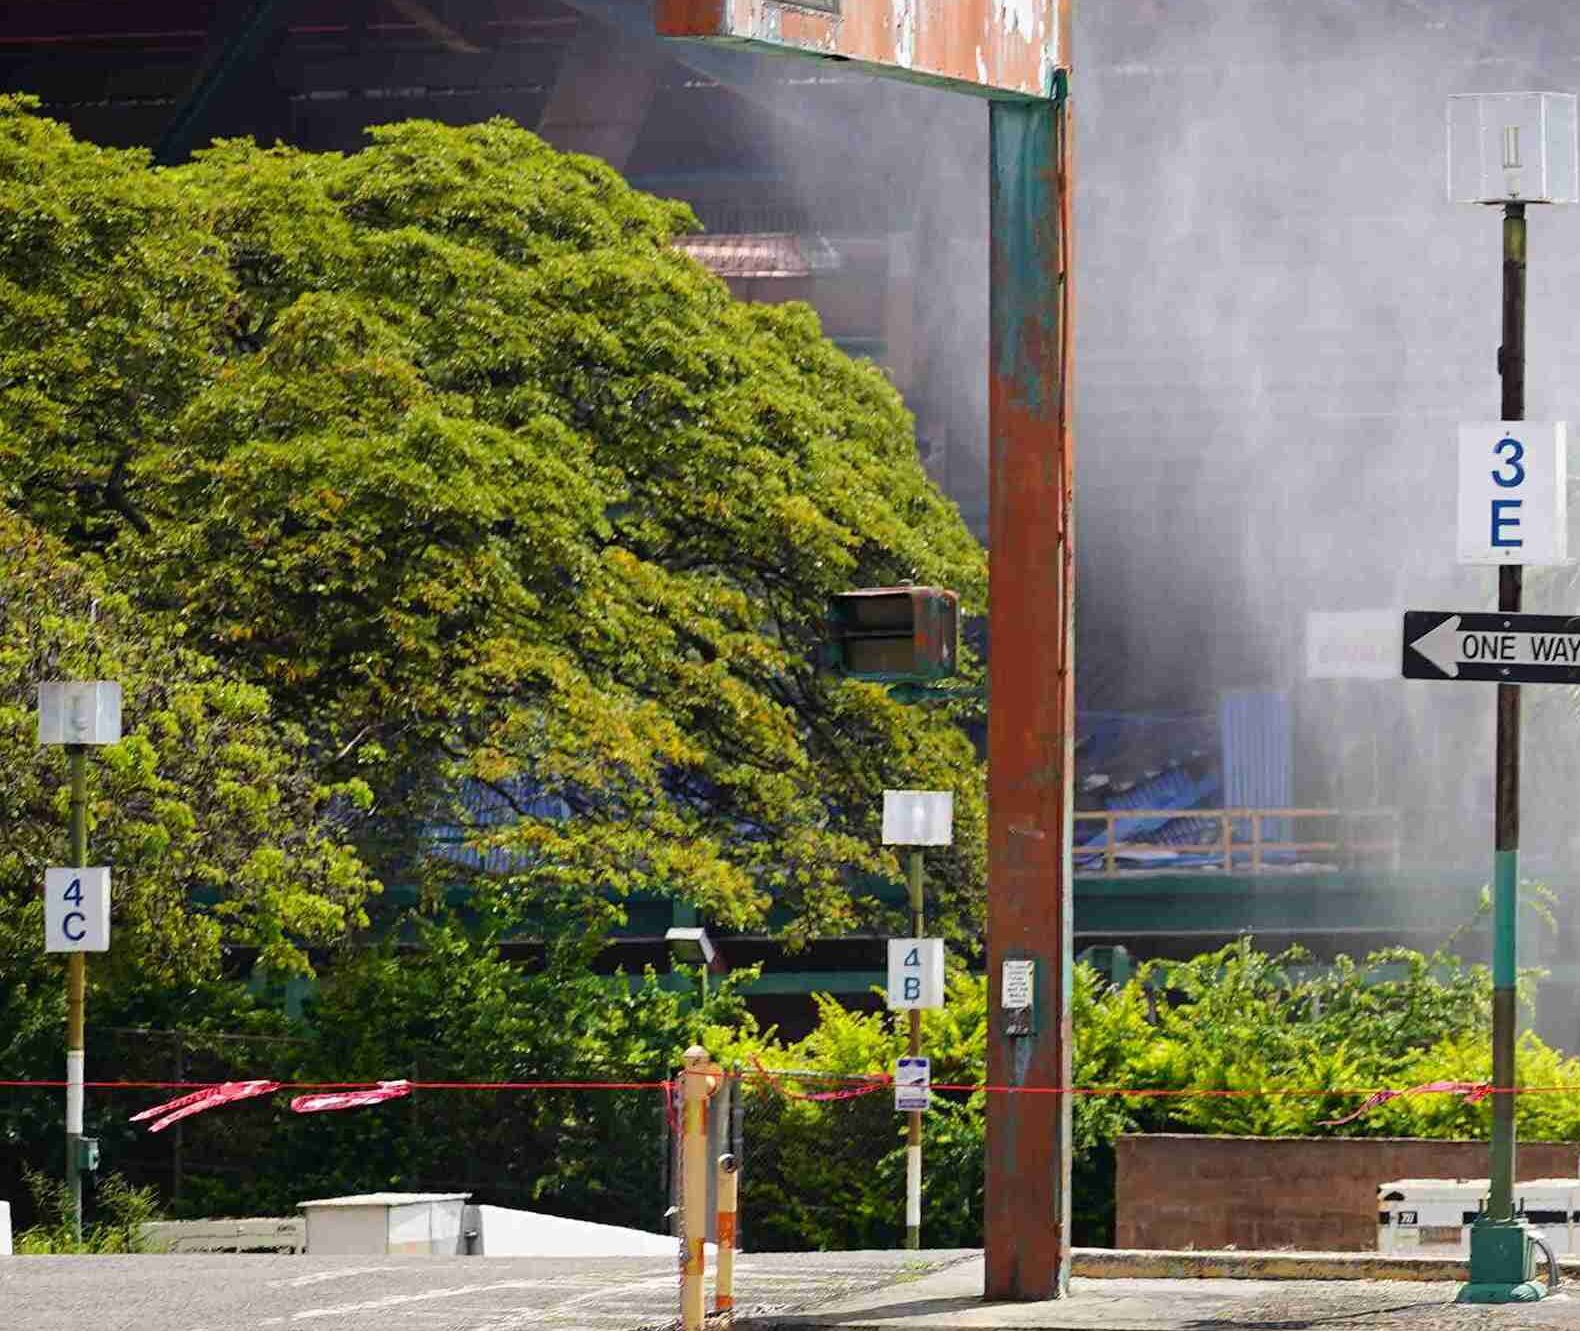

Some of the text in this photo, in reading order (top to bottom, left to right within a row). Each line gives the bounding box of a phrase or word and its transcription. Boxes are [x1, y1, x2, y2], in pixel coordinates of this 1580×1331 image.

[1491, 438, 1525, 488] 3
[1491, 500, 1523, 547] E
[1462, 634, 1516, 660] ONE
[64, 878, 84, 907] 4
[63, 912, 86, 941] C
[904, 948, 920, 967] 4
[904, 977, 920, 1000] B
